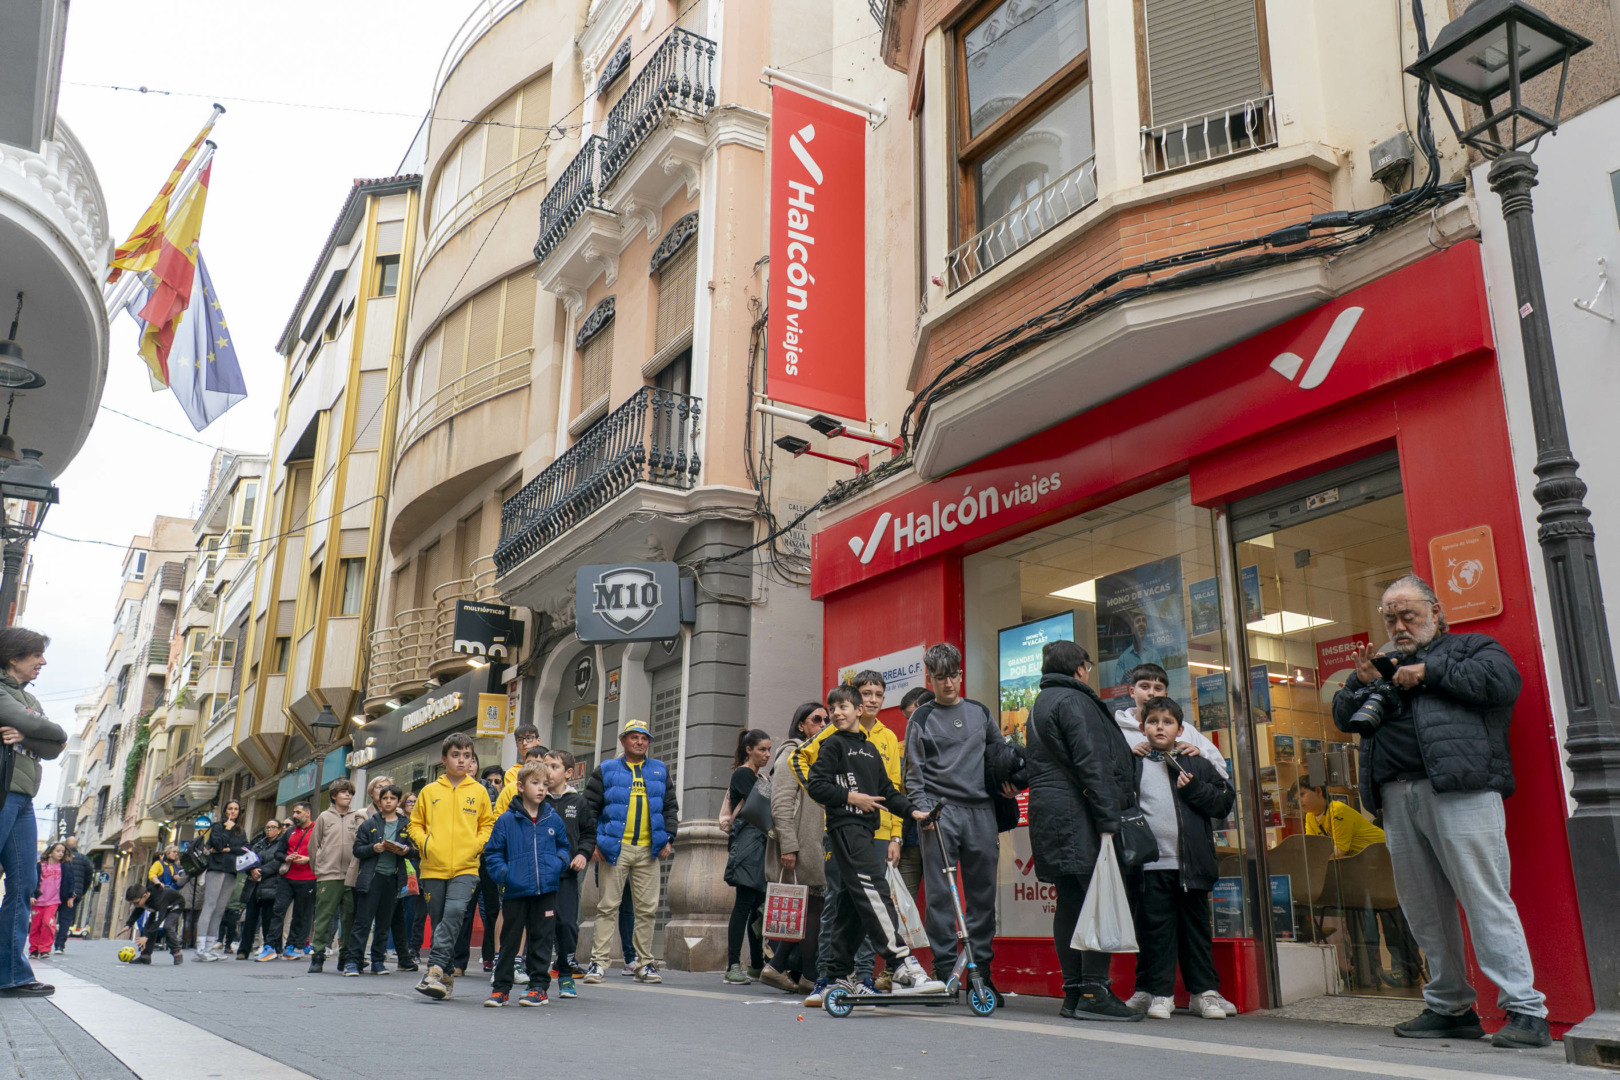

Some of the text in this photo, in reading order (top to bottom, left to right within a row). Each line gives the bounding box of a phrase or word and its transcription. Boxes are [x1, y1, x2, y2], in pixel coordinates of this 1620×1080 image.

[783, 180, 815, 376] Halcón viajes
[788, 503, 808, 512] CALLE
[894, 472, 1062, 552] Halcón viajes
[594, 582, 660, 610] M10
[1106, 583, 1171, 607] MONO DE VACAS
[1194, 589, 1215, 600] VACAS
[1322, 640, 1364, 656] IMSERSO
[1008, 654, 1035, 667] GRANDES
[1324, 657, 1344, 666] Venta
[908, 662, 923, 674] C.F.
[1010, 665, 1027, 677] POR
[847, 772, 857, 786] LOS
[1042, 902, 1056, 913] via
